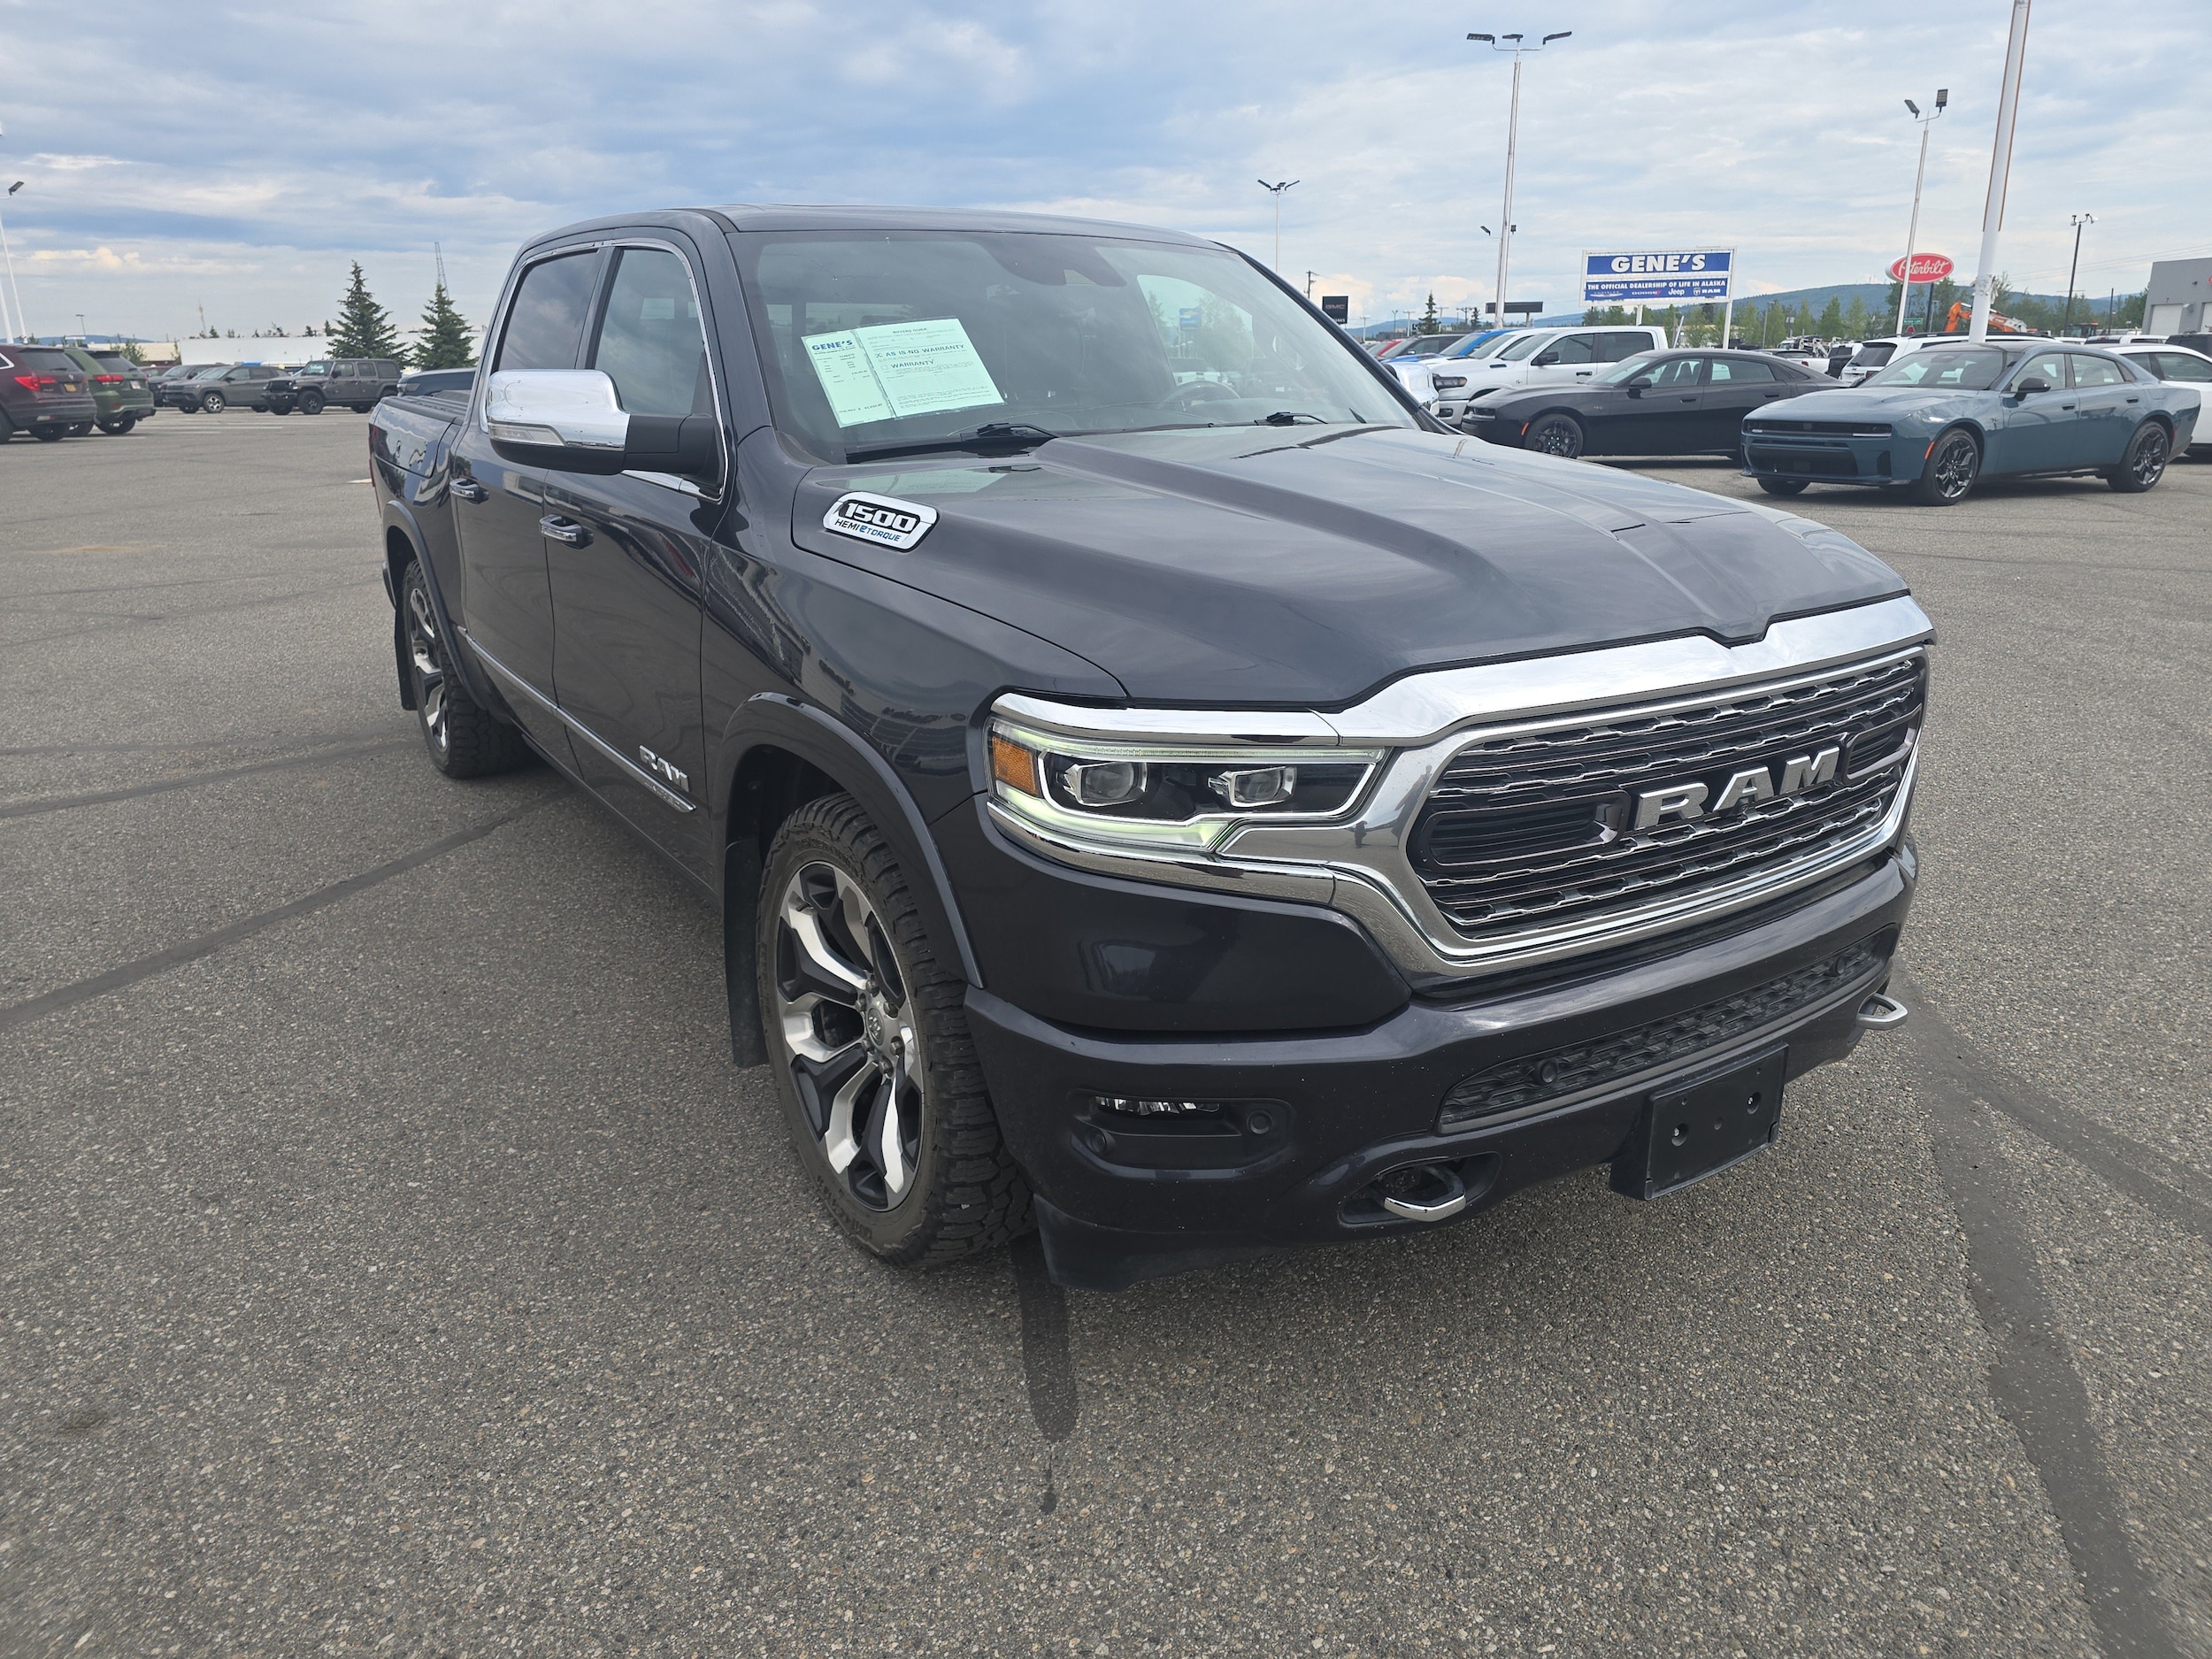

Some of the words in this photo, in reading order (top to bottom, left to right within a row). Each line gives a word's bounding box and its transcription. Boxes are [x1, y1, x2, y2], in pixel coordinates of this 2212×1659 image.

[1610, 254, 1706, 273] GENE'S
[1898, 259, 1949, 277] Pterbilt
[1668, 288, 1685, 296] Jeep
[811, 340, 853, 350] GENE'S
[922, 344, 964, 353] WARRANTY
[891, 359, 934, 369] WARRANTY
[844, 502, 918, 532] 1500
[834, 518, 859, 532] HEMI
[1633, 746, 1840, 830] RAM
